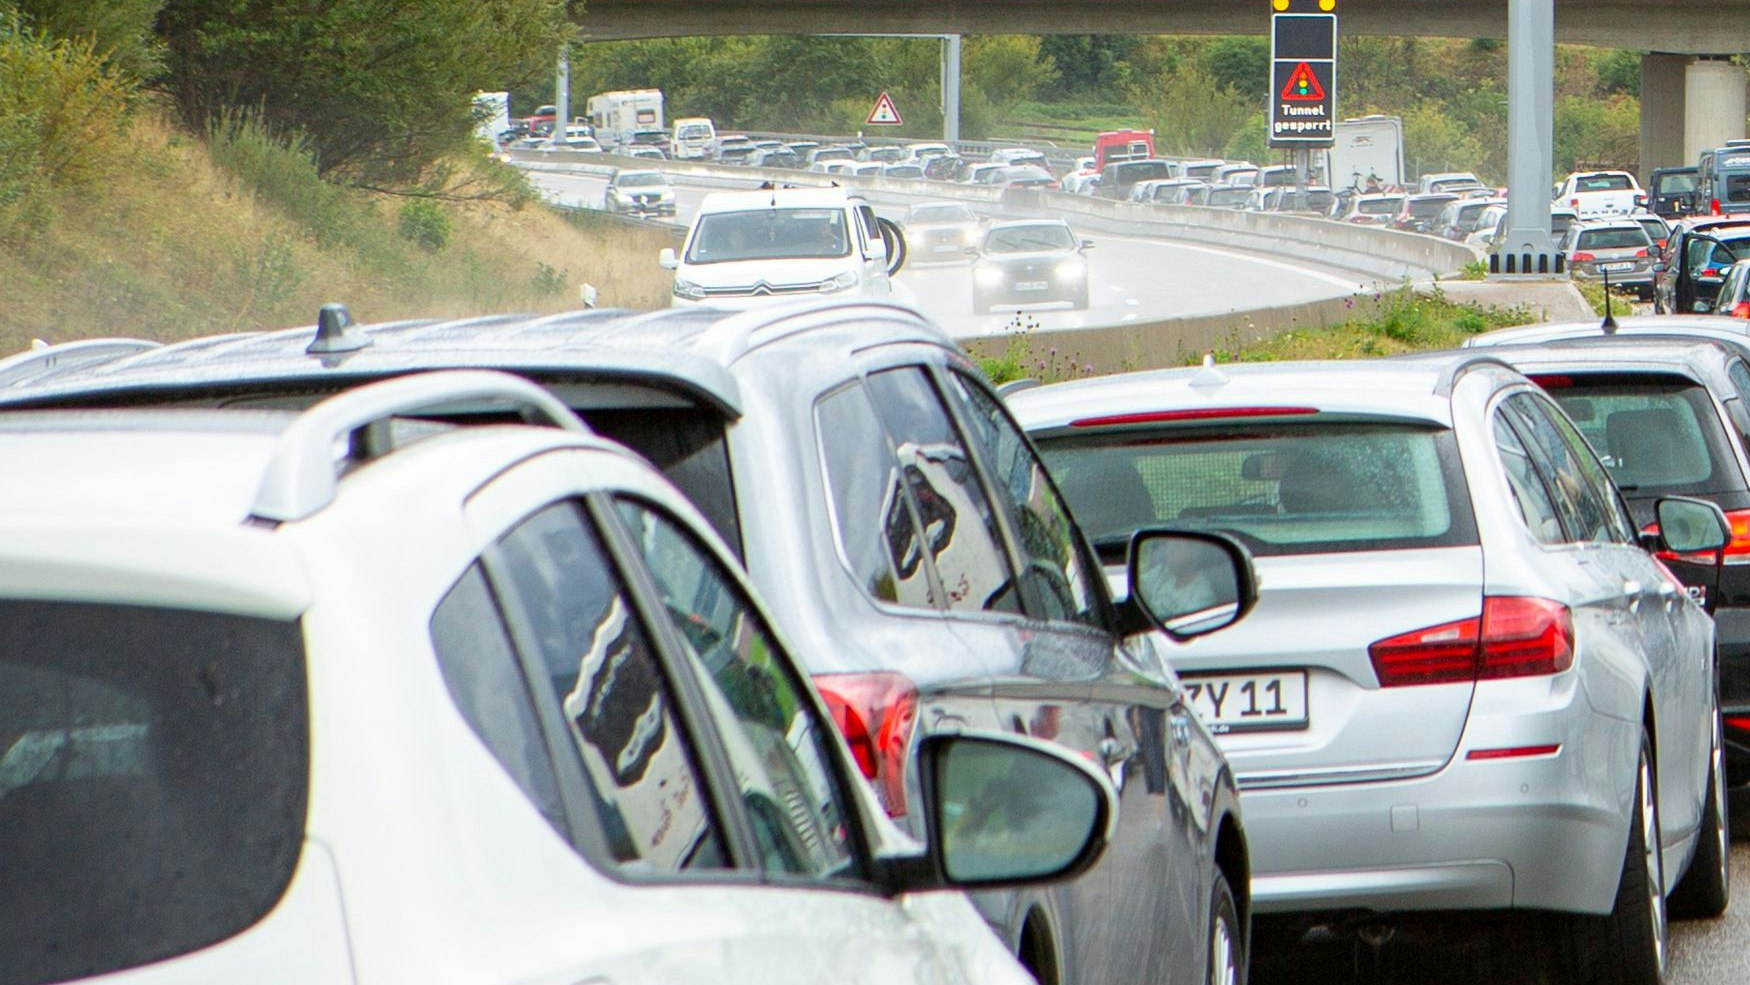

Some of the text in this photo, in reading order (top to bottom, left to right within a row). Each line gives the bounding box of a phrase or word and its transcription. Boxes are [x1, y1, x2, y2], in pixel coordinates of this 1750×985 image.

[1281, 104, 1325, 116] Tunnel
[1275, 119, 1331, 133] gesperrt
[1240, 679, 1287, 716] 11
